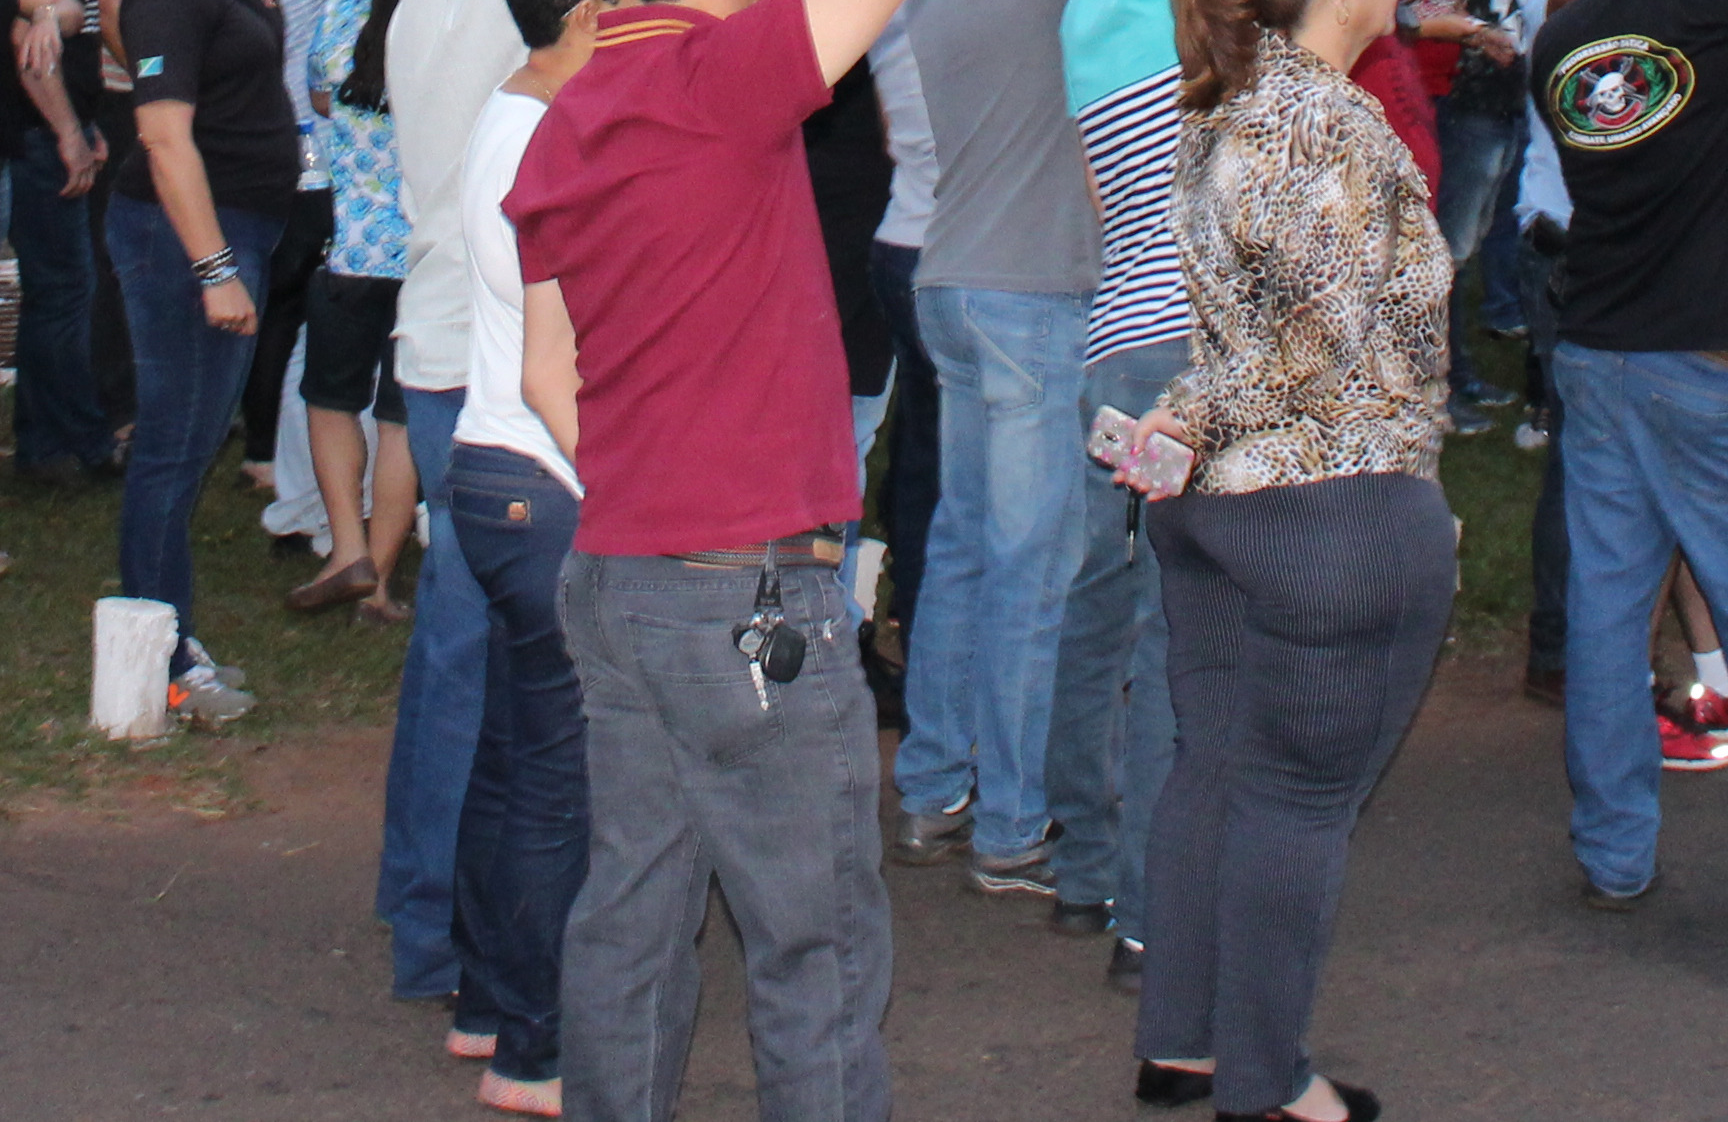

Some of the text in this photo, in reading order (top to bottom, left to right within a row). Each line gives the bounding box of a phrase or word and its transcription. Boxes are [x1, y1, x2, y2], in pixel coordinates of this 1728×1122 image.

[1568, 93, 1683, 145] COMBATE URBANO AVANÇADO
